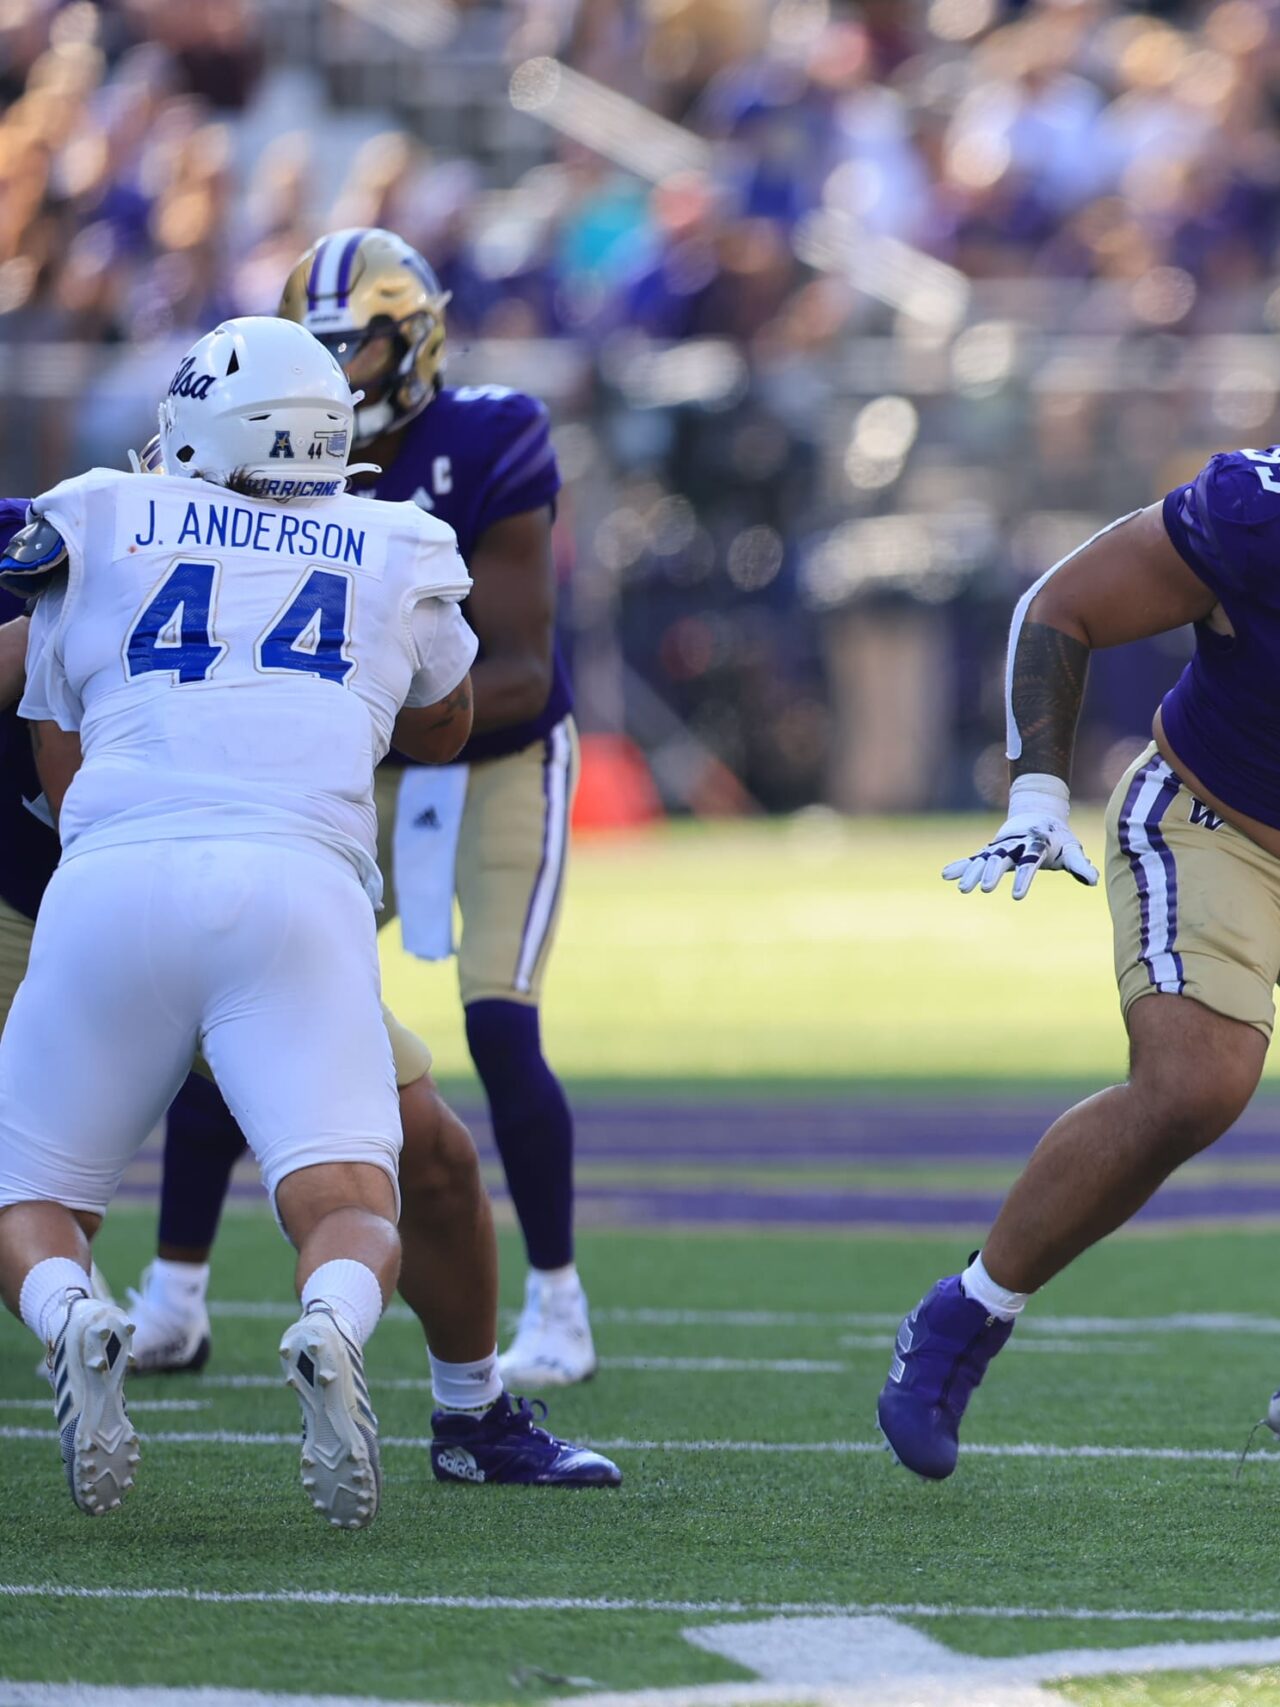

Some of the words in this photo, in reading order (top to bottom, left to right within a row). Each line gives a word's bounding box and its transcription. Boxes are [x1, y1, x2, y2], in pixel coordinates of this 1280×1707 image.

[168, 356, 217, 400] lsa
[307, 442, 322, 459] 44
[247, 479, 341, 497] RRICANE
[432, 456, 452, 495] C
[135, 500, 163, 547] J.
[177, 501, 366, 567] ANDERSON
[123, 557, 357, 688] 44
[1188, 796, 1226, 832] W
[437, 1453, 485, 1482] adidas
